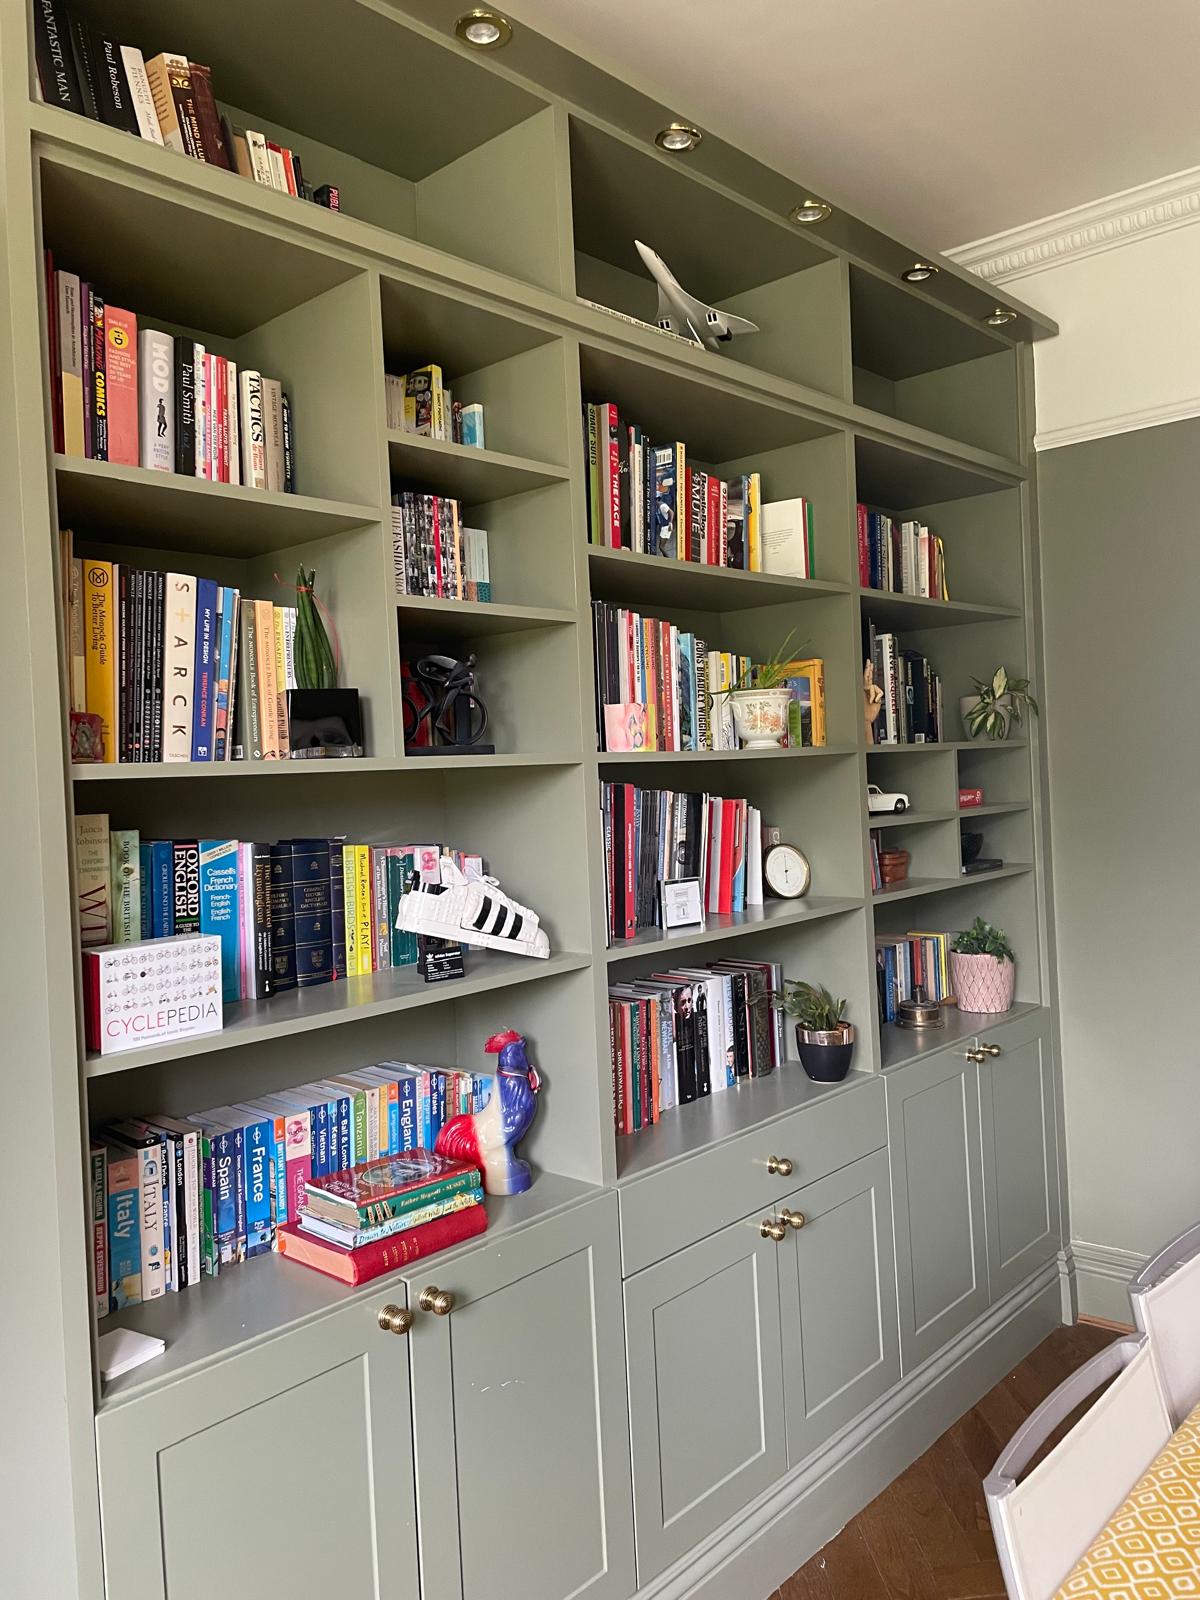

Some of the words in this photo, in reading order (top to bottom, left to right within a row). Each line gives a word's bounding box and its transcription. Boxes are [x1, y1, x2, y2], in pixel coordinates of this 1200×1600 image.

[41, 0, 63, 67] FANTASTIC
[56, 71, 70, 102] MAN
[104, 41, 115, 63] Paul
[108, 66, 123, 109] Robeson
[186, 98, 194, 114] THE
[191, 116, 200, 139] MIND
[152, 343, 170, 393] MOD
[182, 364, 193, 388] Paul
[95, 372, 105, 416] COMICS
[182, 390, 194, 424] Smith
[249, 376, 262, 442] TACTICS
[692, 484, 701, 533] MUTE
[92, 593, 99, 602] To
[205, 609, 210, 618] MY
[92, 627, 100, 650] Living
[98, 610, 106, 641] Monocle
[99, 644, 107, 665] Guide
[697, 666, 705, 703] BRADLEY
[250, 698, 259, 742] Entrepreneurs
[698, 707, 706, 743] WIGGINS
[175, 850, 187, 917] ENGLISH
[187, 849, 199, 916] OXFORD
[255, 864, 264, 924] Etymologicon
[345, 860, 354, 898] BRITISH
[346, 902, 355, 929] BIRDS
[360, 921, 369, 950] PLAY!
[106, 1002, 217, 1037] CYCLEPEDIA
[356, 1110, 364, 1156] Tanzania
[217, 1156, 231, 1200] Spain
[252, 1147, 265, 1202] France
[296, 1168, 304, 1184] THE
[96, 1191, 104, 1217] FIGURA
[114, 1193, 134, 1238] Italy
[143, 1178, 158, 1232] ITALY
